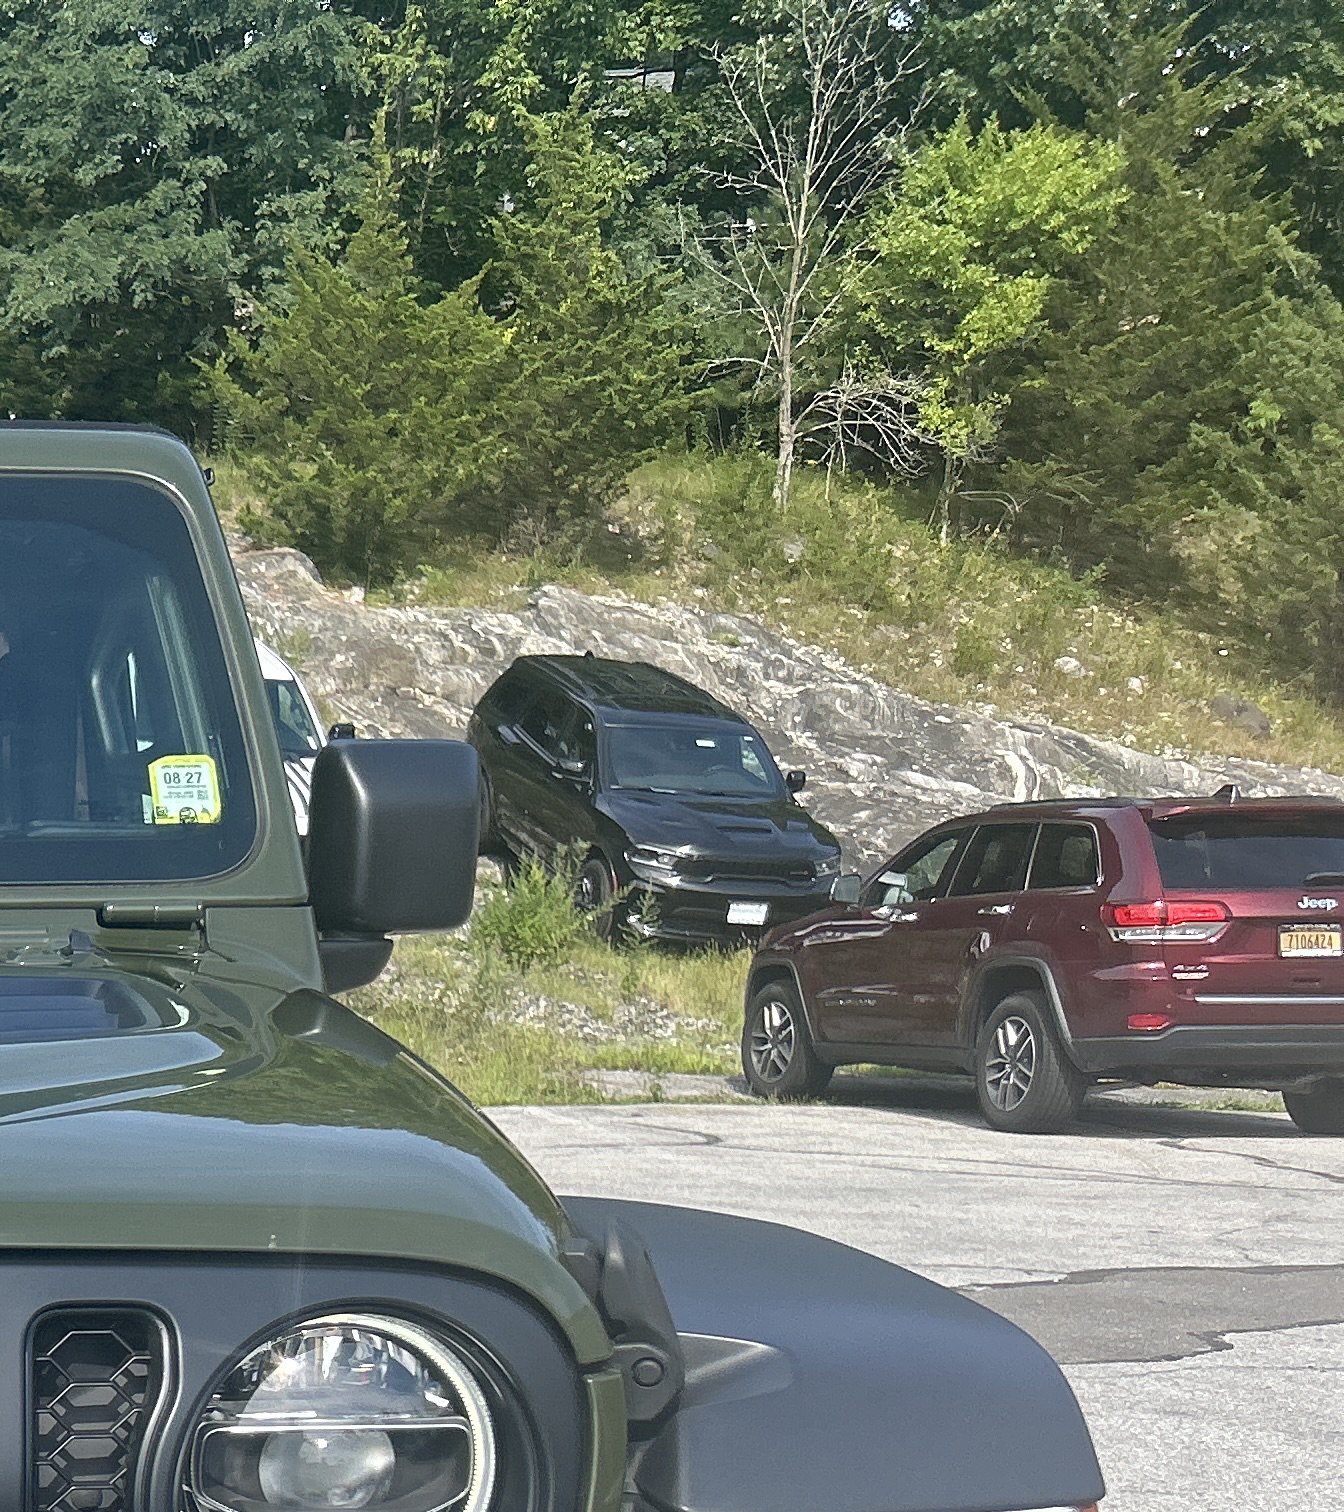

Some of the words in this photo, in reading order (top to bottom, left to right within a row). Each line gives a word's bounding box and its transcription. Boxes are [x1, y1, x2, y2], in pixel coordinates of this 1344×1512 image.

[163, 771, 181, 785] 08
[185, 771, 202, 784] 27
[1297, 896, 1338, 911] Jeep
